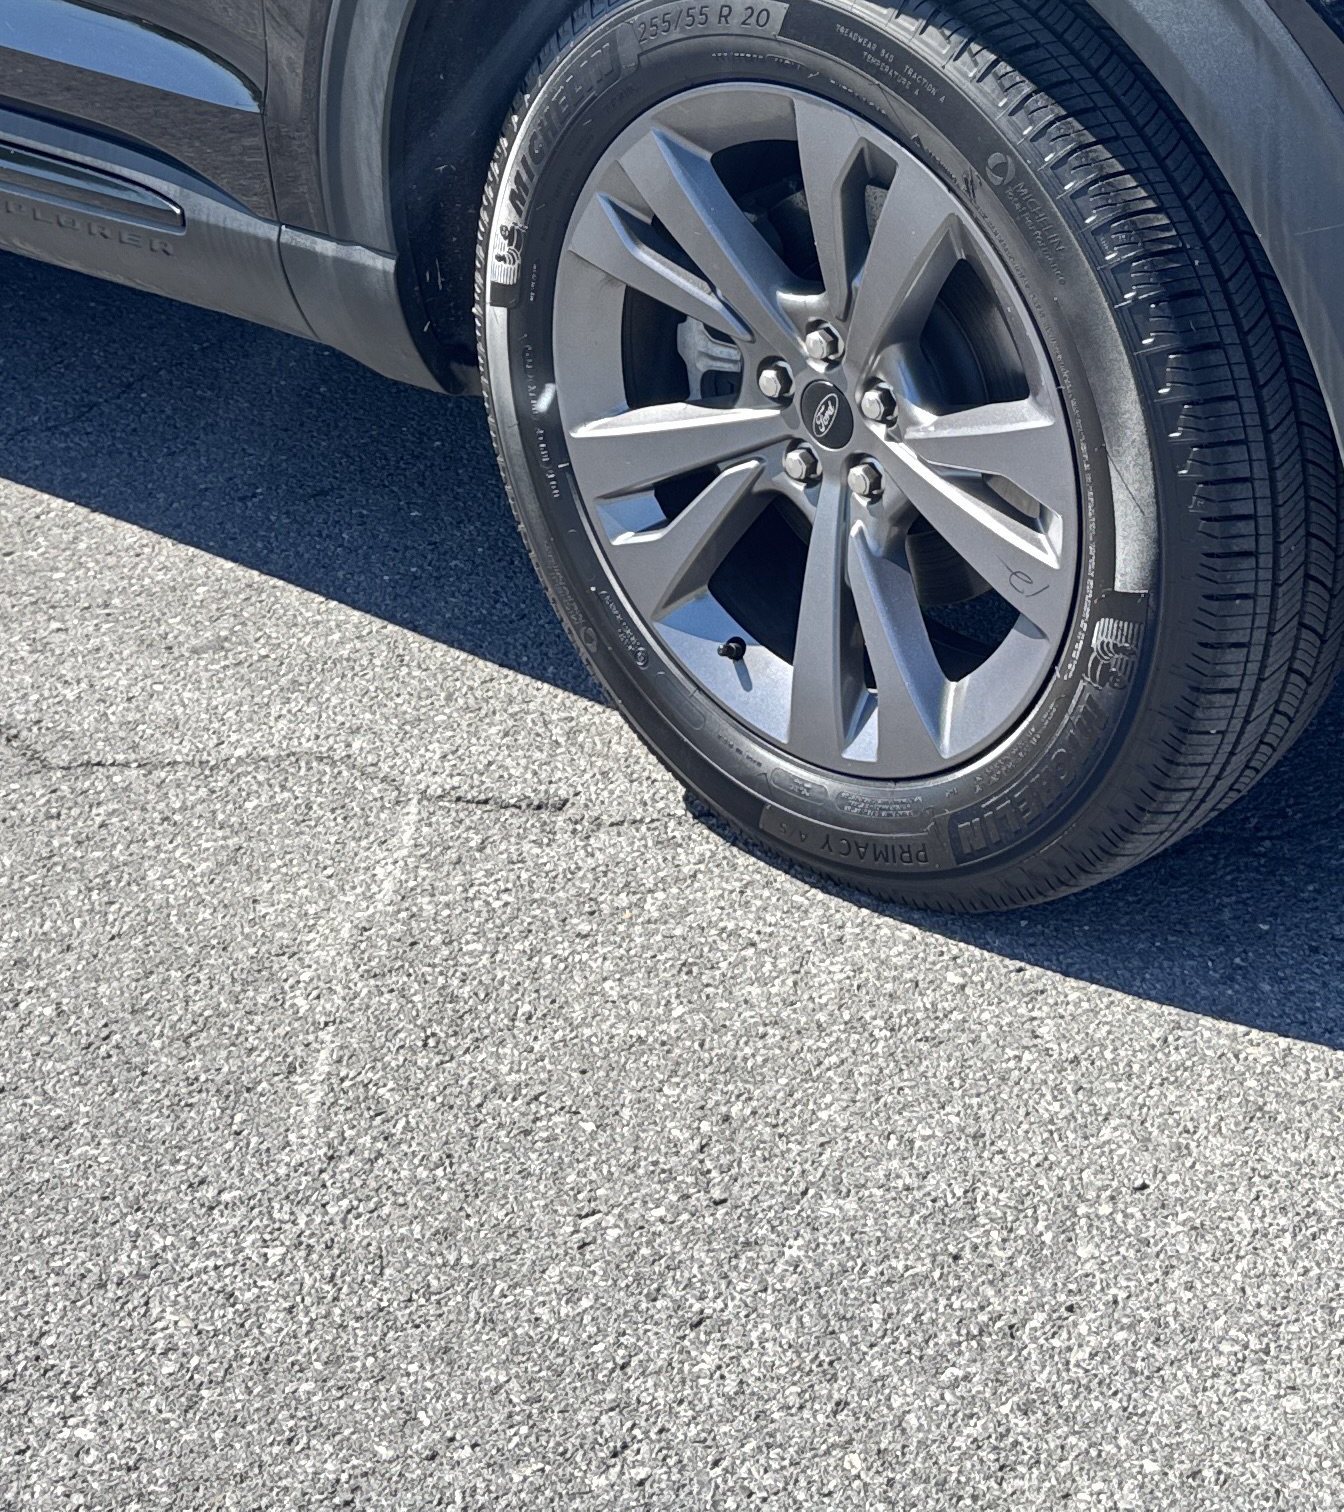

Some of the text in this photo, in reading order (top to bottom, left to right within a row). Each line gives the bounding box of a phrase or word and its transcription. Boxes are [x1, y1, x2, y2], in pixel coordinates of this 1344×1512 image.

[639, 4, 771, 43] 255/55 R 20
[508, 41, 622, 219] MICHELIN
[1013, 182, 1066, 252] MICHELIN
[815, 400, 836, 433] Ford
[958, 693, 1106, 854] MICHELIN
[820, 832, 930, 866] PRIMACY
